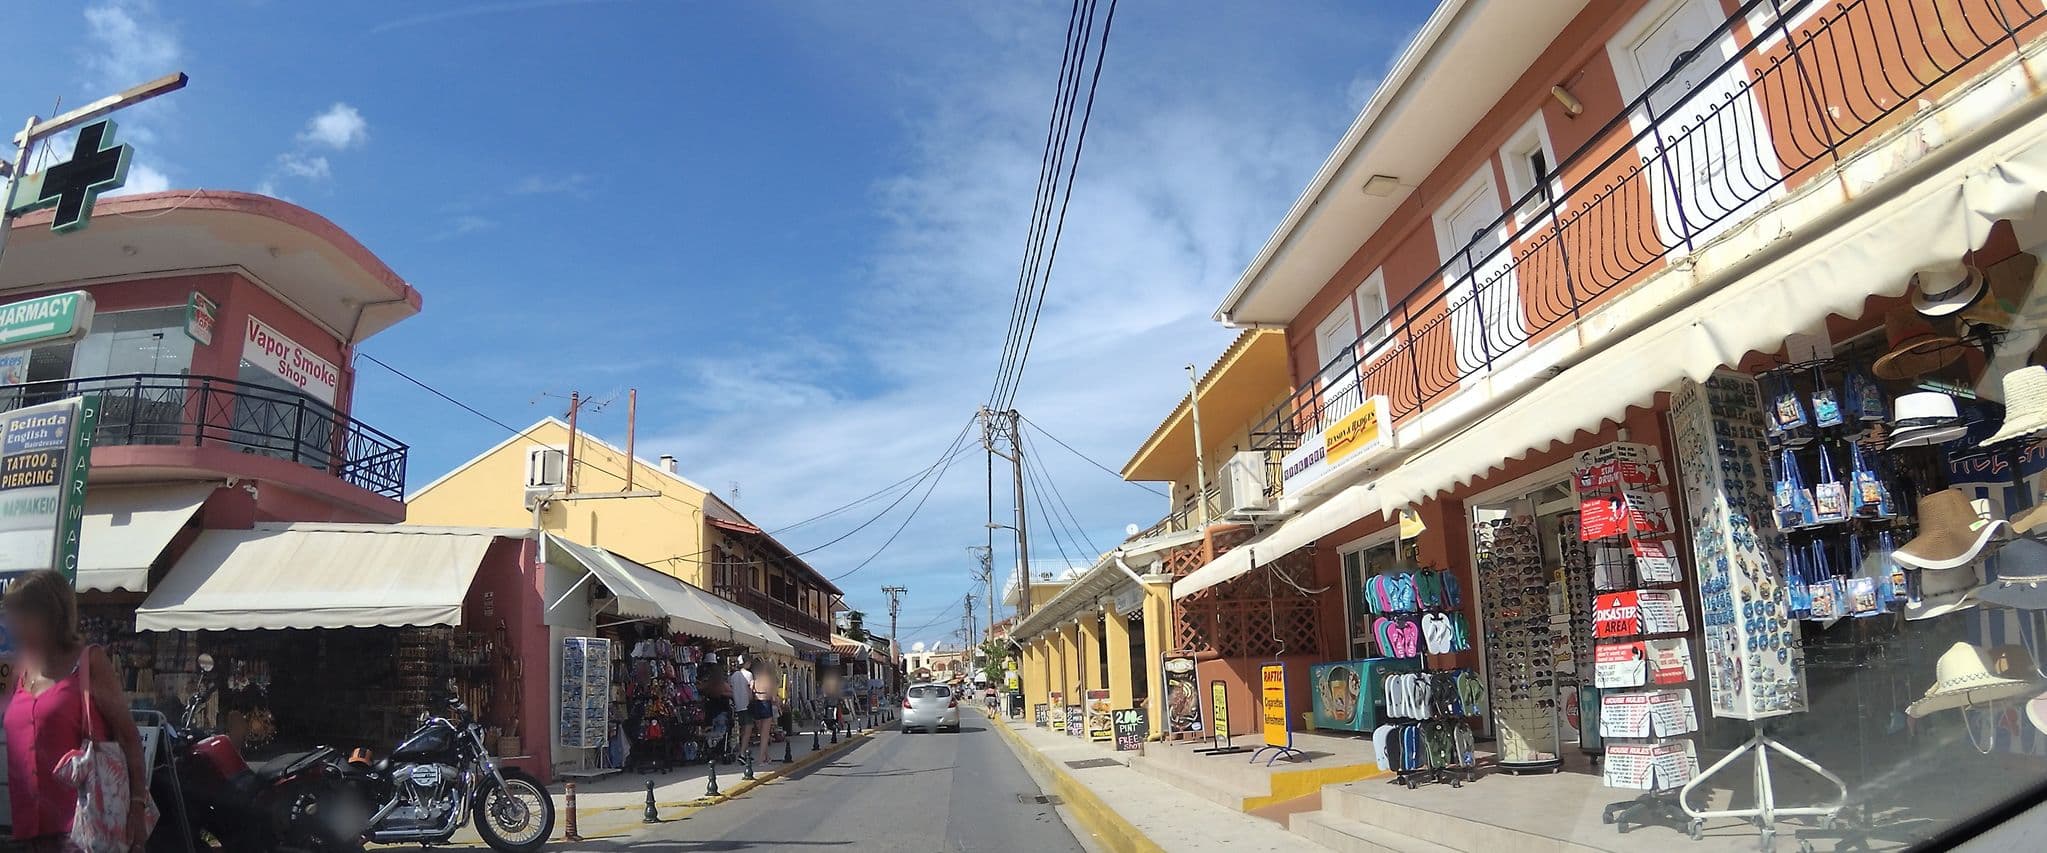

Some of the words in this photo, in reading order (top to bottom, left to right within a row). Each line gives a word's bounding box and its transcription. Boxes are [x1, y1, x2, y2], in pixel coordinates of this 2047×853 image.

[1685, 80, 1692, 90] 3
[248, 319, 291, 361] Vapor
[293, 347, 336, 388] Smoke
[278, 359, 307, 389] Shop
[10, 414, 67, 432] Belinda
[7, 428, 48, 445] English
[7, 453, 48, 472] TATTOO
[51, 457, 58, 469] &
[1601, 464, 1615, 475] STAY
[2, 469, 54, 489] PIERCING
[65, 408, 94, 585] PHARMAC
[1597, 605, 1636, 621] DISASTER
[1605, 621, 1627, 633] AREA
[1263, 670, 1283, 682] RAFTIS
[1120, 723, 1138, 733] PINT
[1118, 734, 1140, 744] FREE
